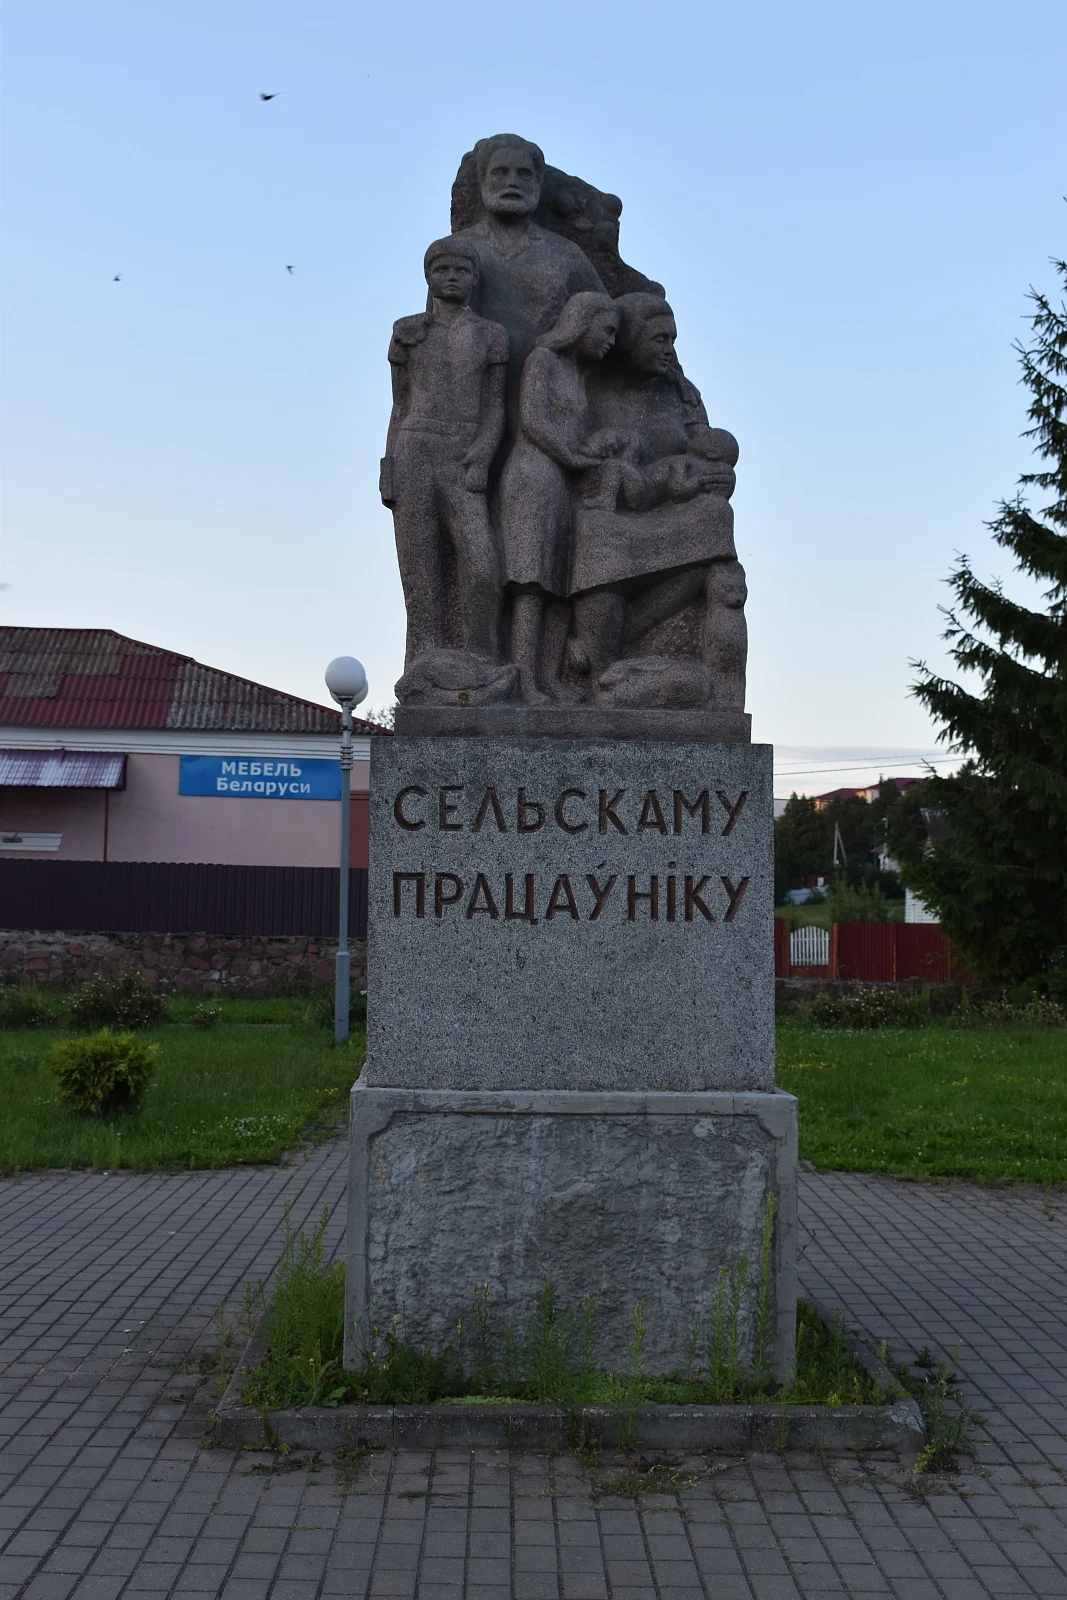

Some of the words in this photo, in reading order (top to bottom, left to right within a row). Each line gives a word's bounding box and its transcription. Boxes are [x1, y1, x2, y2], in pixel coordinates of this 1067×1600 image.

[221, 761, 302, 777] МЕБЕЛЬ
[216, 777, 311, 796] Беларуси
[393, 785, 749, 837] СЕЛЬСКАМУ
